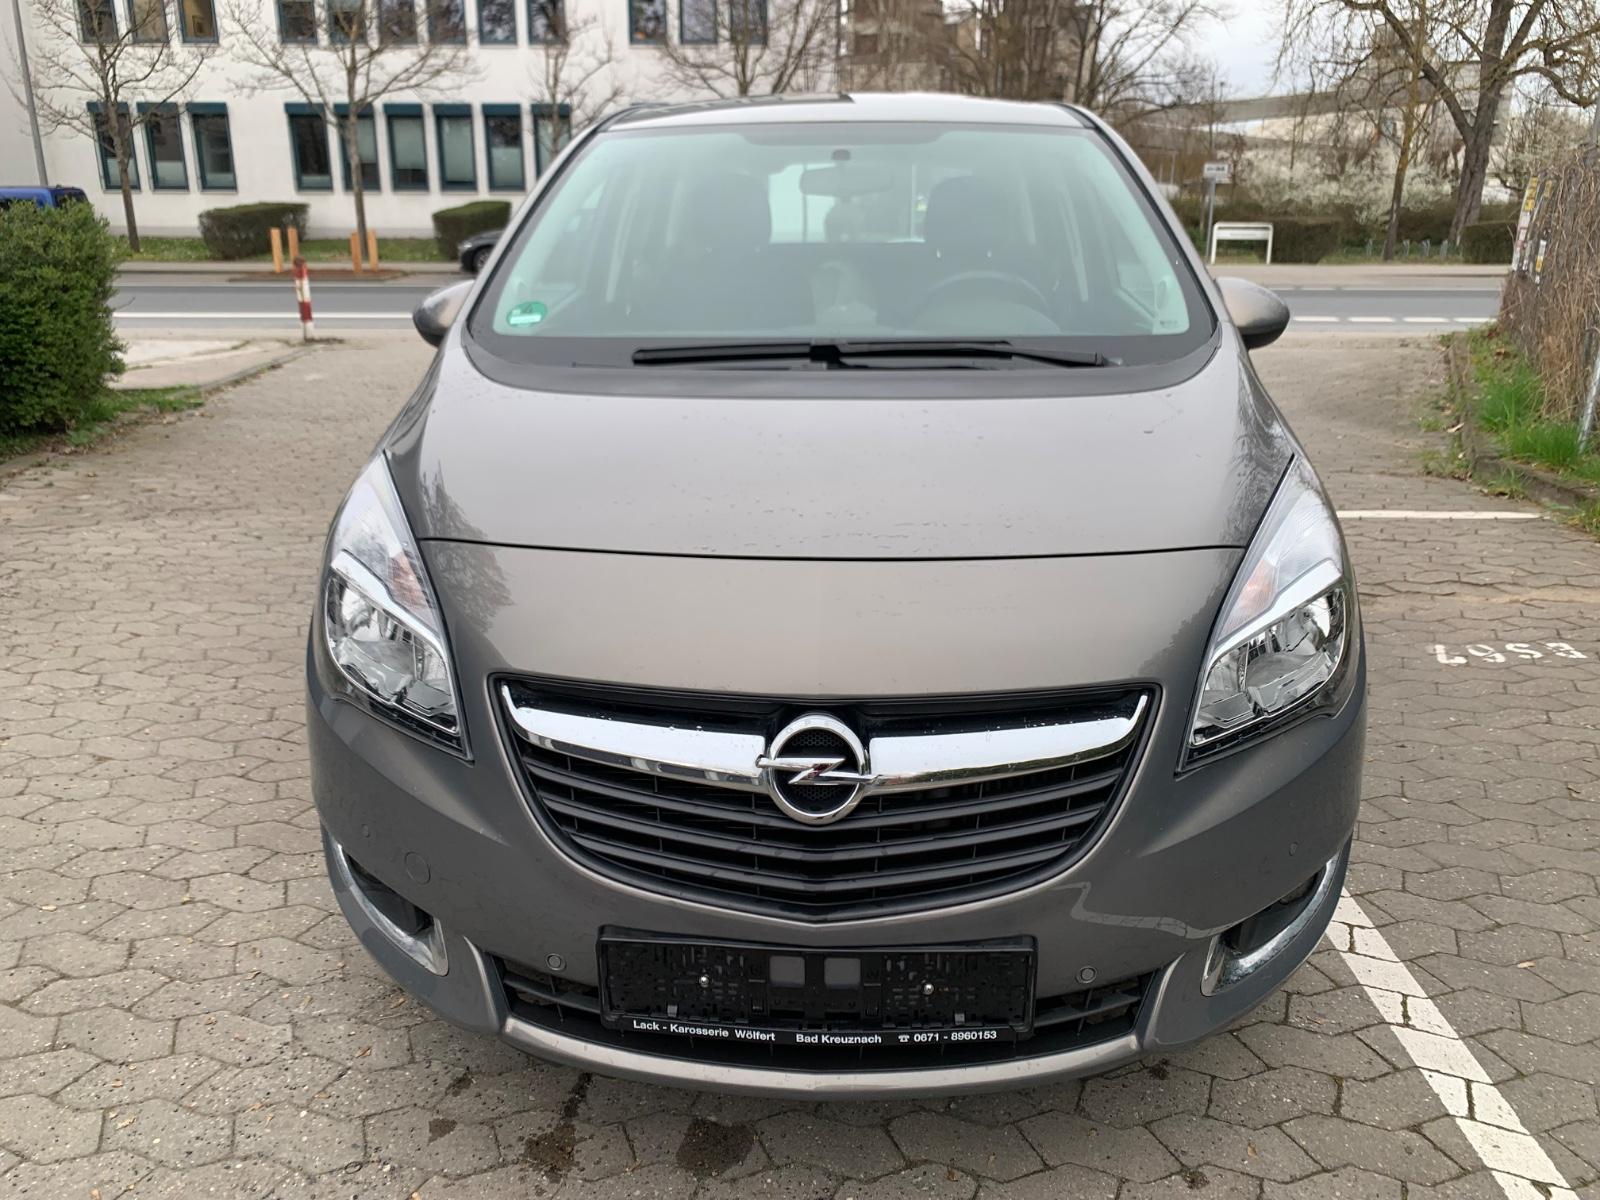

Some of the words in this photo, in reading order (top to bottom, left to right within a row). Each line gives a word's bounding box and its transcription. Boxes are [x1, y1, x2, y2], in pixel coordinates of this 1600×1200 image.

[633, 1020, 660, 1031] Lack
[670, 1023, 729, 1038] Karosserie
[735, 1028, 776, 1041] Wölfert
[796, 1033, 818, 1044] Bad
[821, 1034, 882, 1044] Kreuznach
[913, 1033, 940, 1042] 0671
[951, 1030, 997, 1041] 8960153
